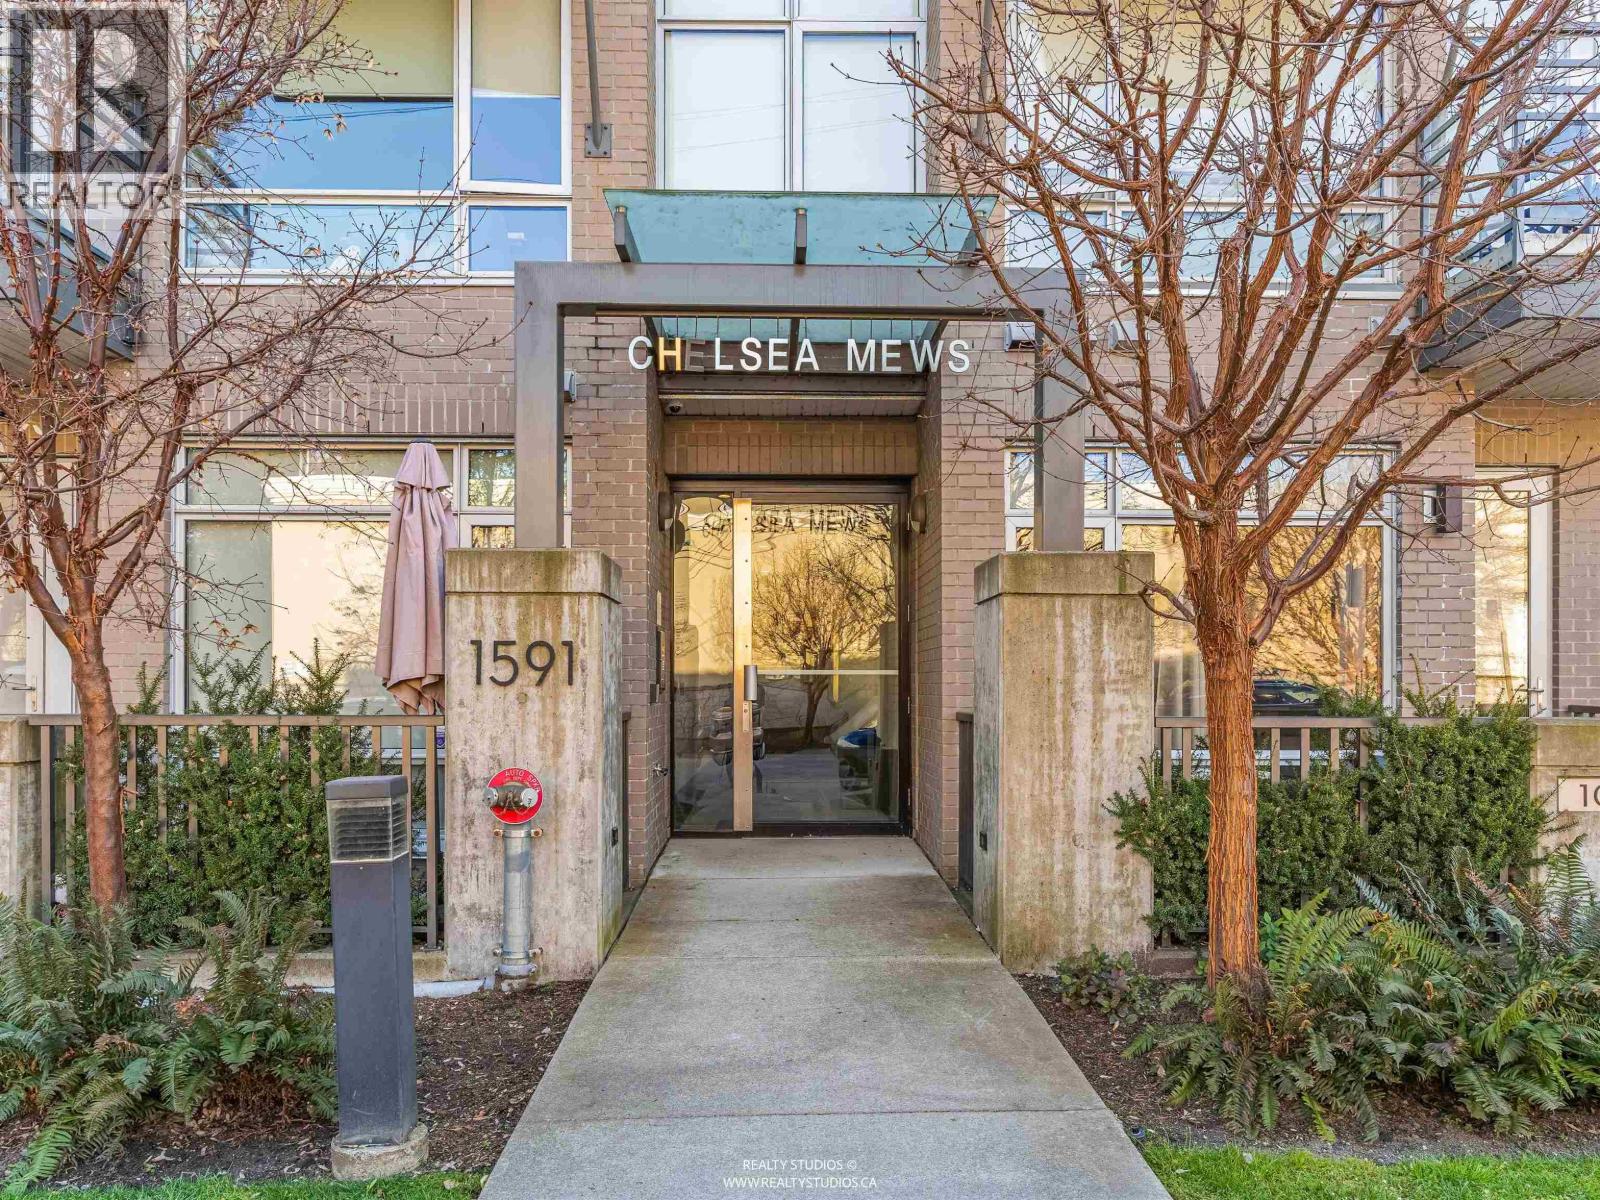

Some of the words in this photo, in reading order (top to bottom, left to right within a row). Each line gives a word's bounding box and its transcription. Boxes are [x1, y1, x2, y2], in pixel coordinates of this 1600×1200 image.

[628, 335, 820, 372] CHELSEA
[846, 338, 970, 373] MEWS
[470, 639, 573, 687] 1591
[505, 769, 525, 777] AUTO
